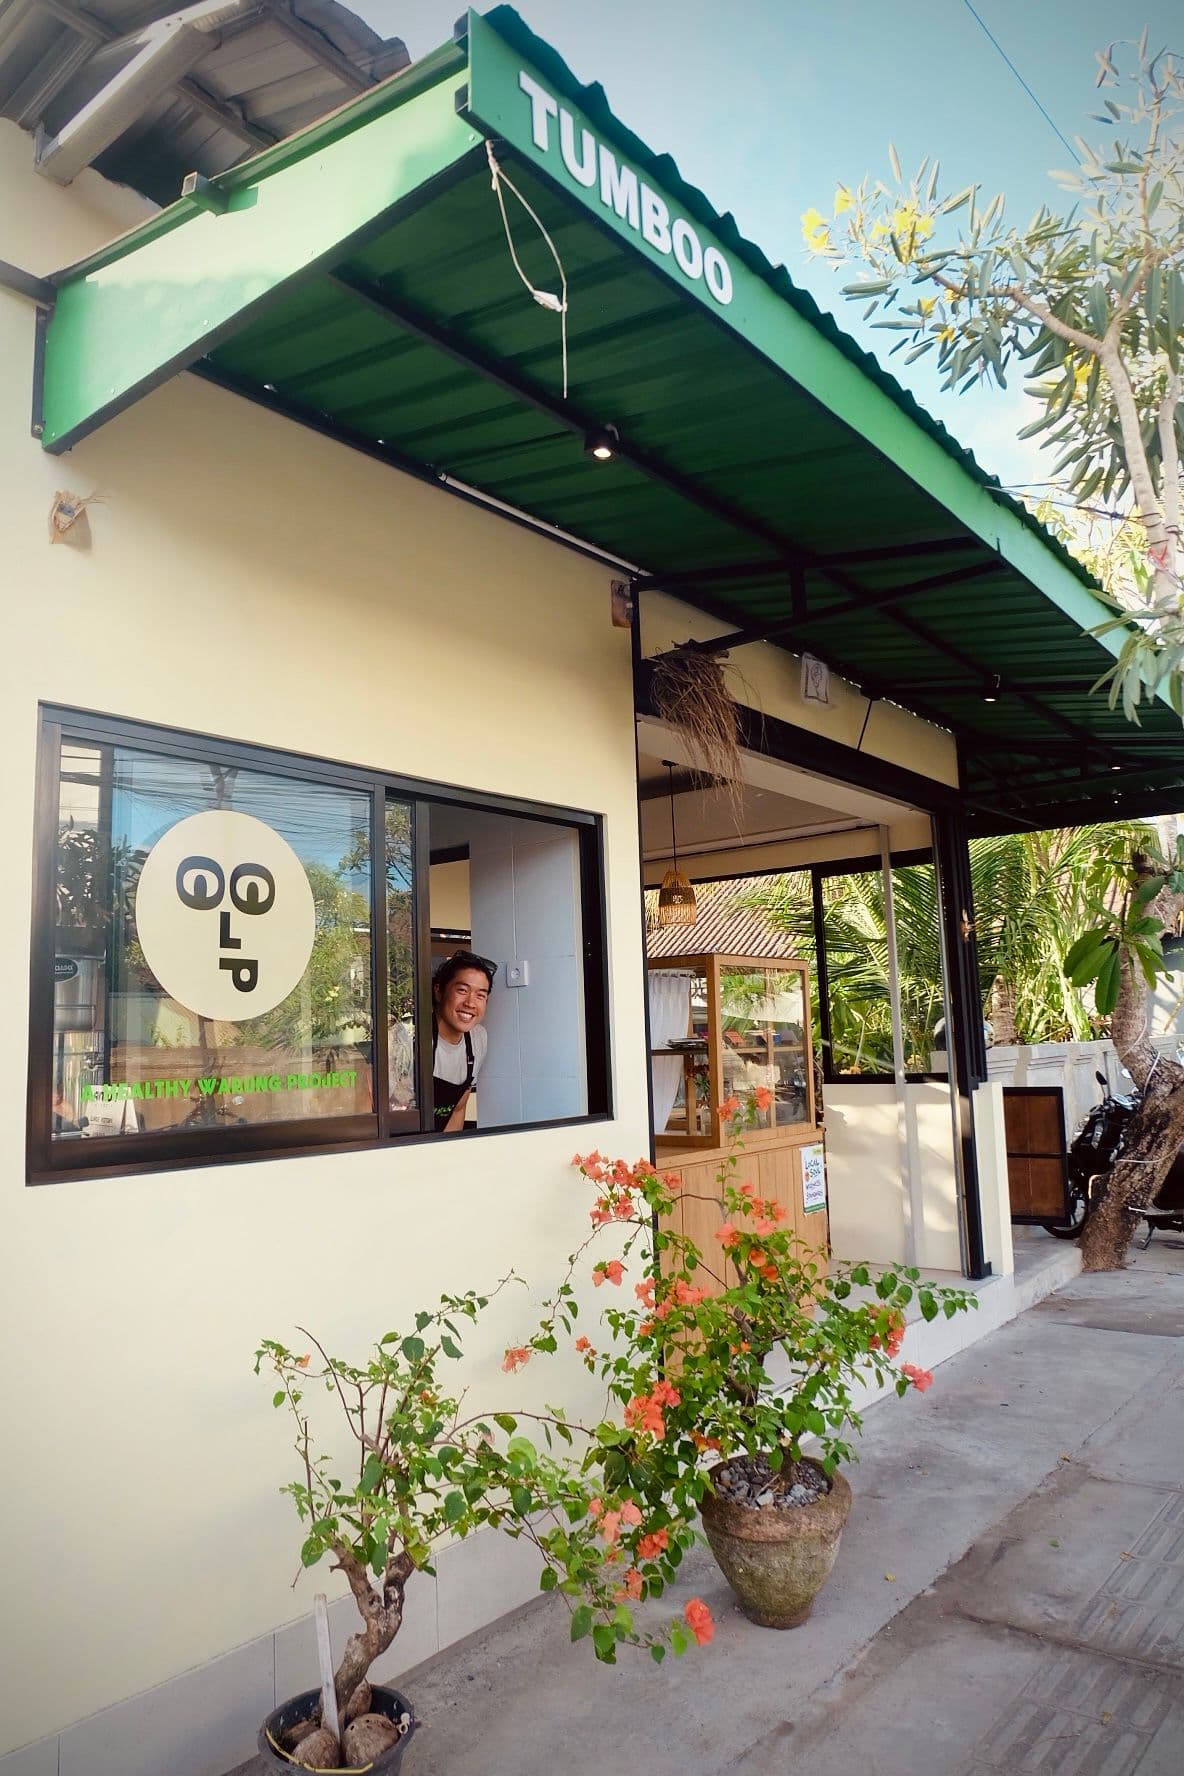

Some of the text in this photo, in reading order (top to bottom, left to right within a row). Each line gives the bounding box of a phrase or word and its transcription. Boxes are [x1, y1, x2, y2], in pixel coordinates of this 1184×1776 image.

[519, 70, 734, 306] TUMBOO
[81, 1083, 96, 1103] A
[102, 1079, 192, 1103] HEALTHY
[198, 1074, 282, 1096] WARUNG
[287, 1071, 358, 1092] PROJECT
